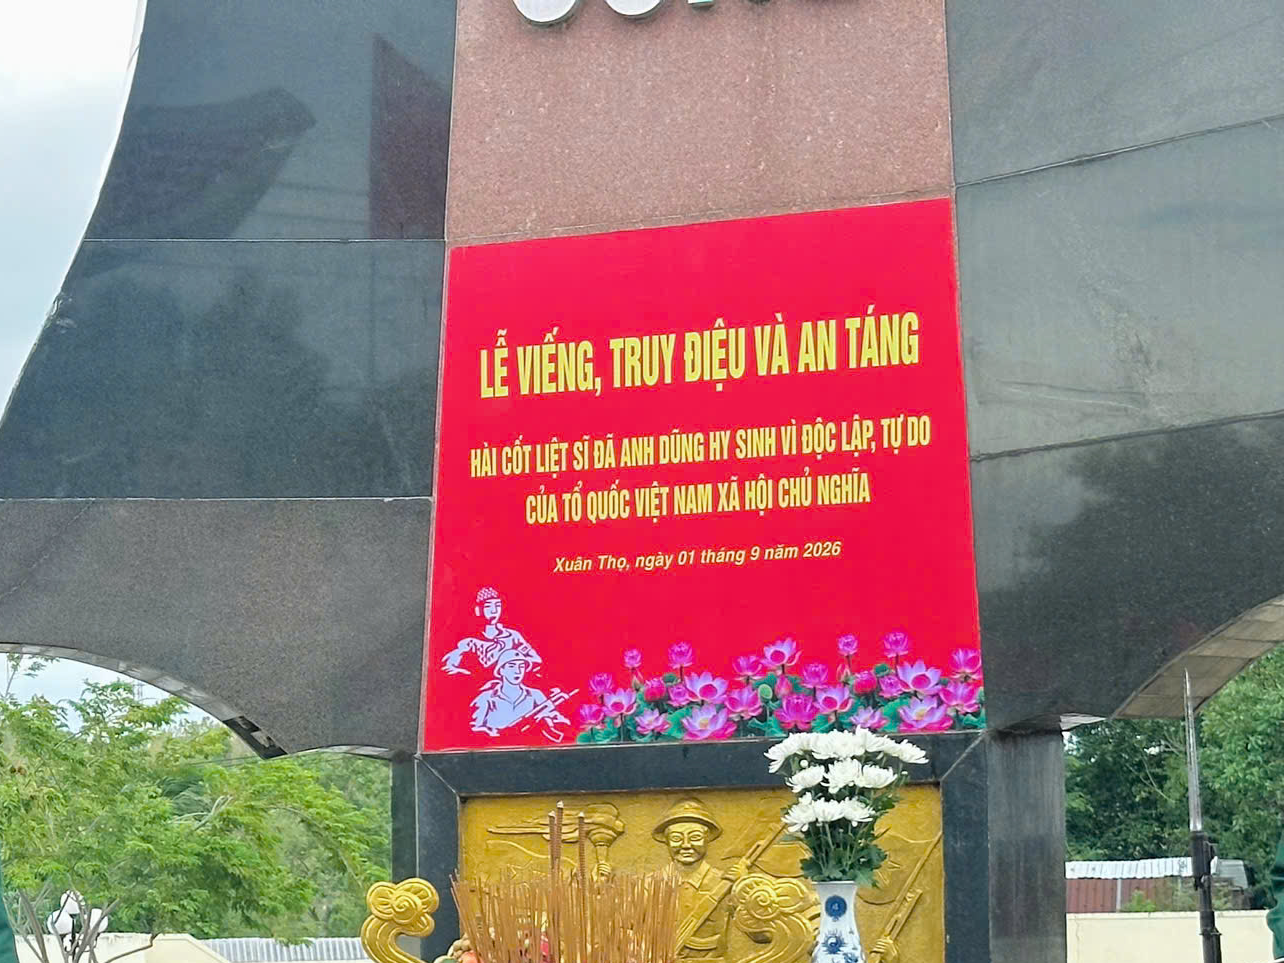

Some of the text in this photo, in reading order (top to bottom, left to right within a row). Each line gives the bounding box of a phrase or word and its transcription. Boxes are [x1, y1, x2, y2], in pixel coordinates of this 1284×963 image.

[480, 305, 919, 398] LỄ VIẾNG, TRUY ĐIỆU VÀ AN TÁNG
[471, 414, 930, 478] HÀI CỐT LIỆT SĨ ĐÃ ANH DŨNG HY SINH VÌ ĐỘC LẬP, TỰ DO
[526, 467, 871, 524] CỦA TỔ QUỐC VIỆT NAM XÃ HỘI CHỦ NGHĨA
[553, 541, 842, 573] Xuân Thọ, ngày 01 tháng 9 năm 2026
